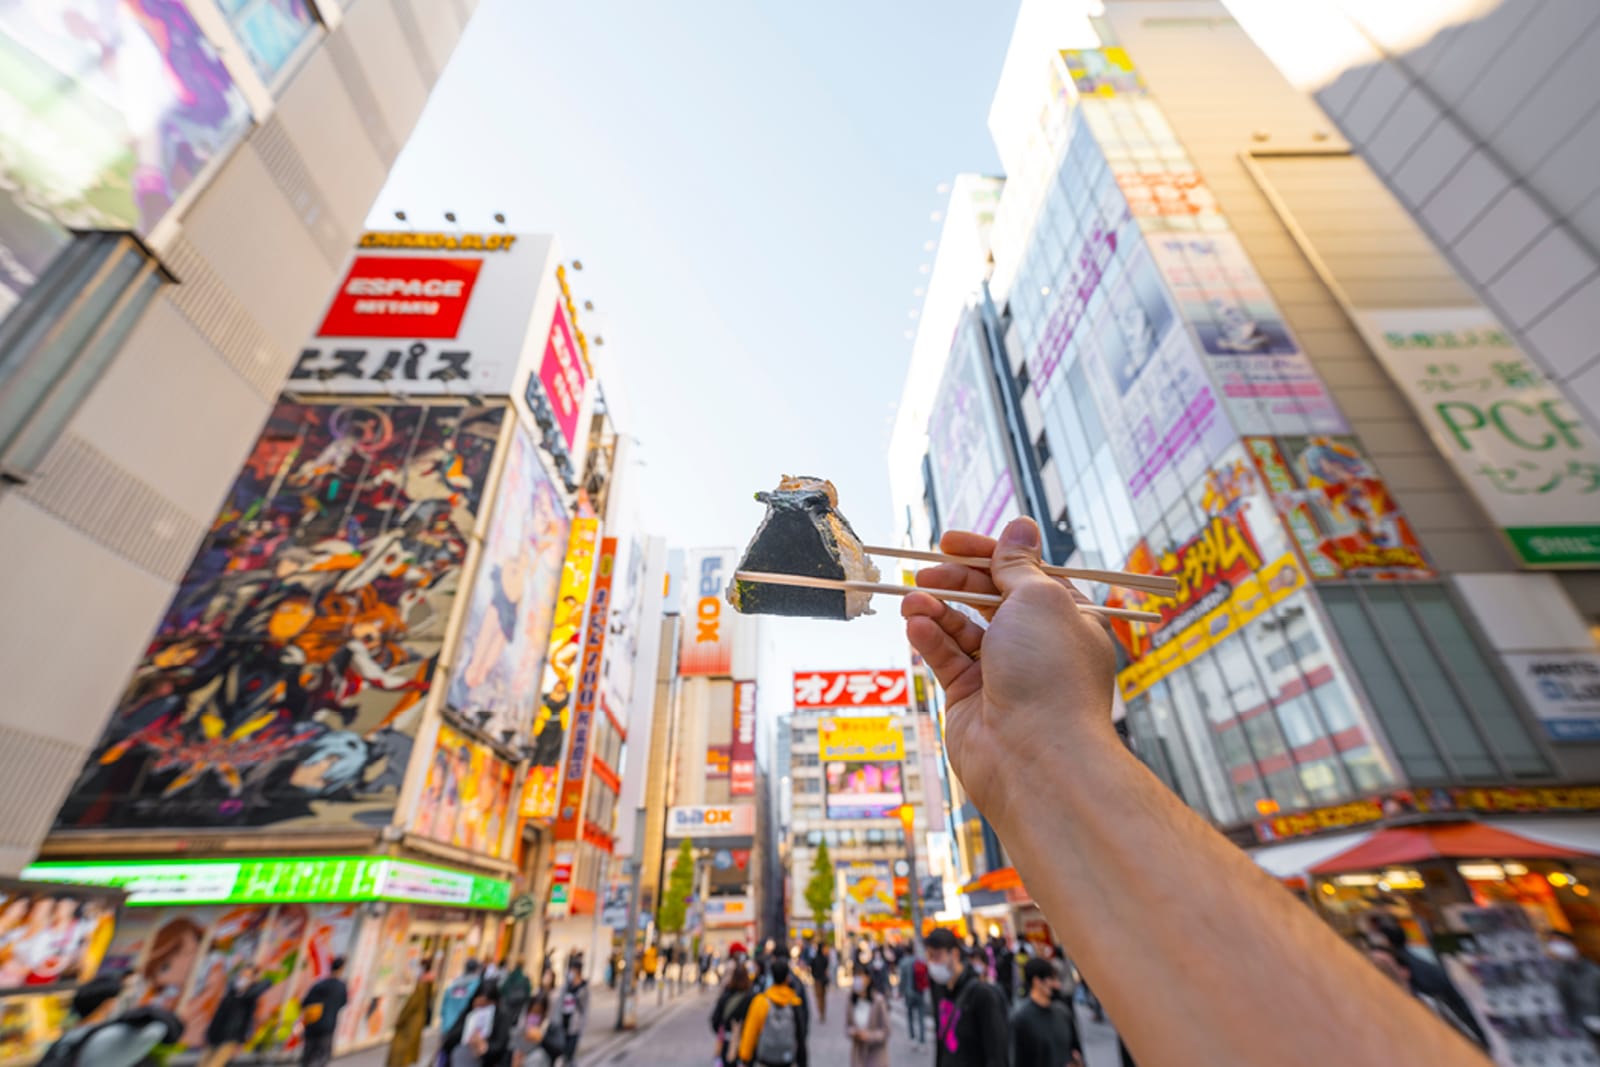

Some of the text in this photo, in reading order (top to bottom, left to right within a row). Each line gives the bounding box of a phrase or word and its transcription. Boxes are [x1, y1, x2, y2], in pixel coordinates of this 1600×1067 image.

[346, 277, 465, 297] ESPACE
[796, 671, 906, 704] オノデン
